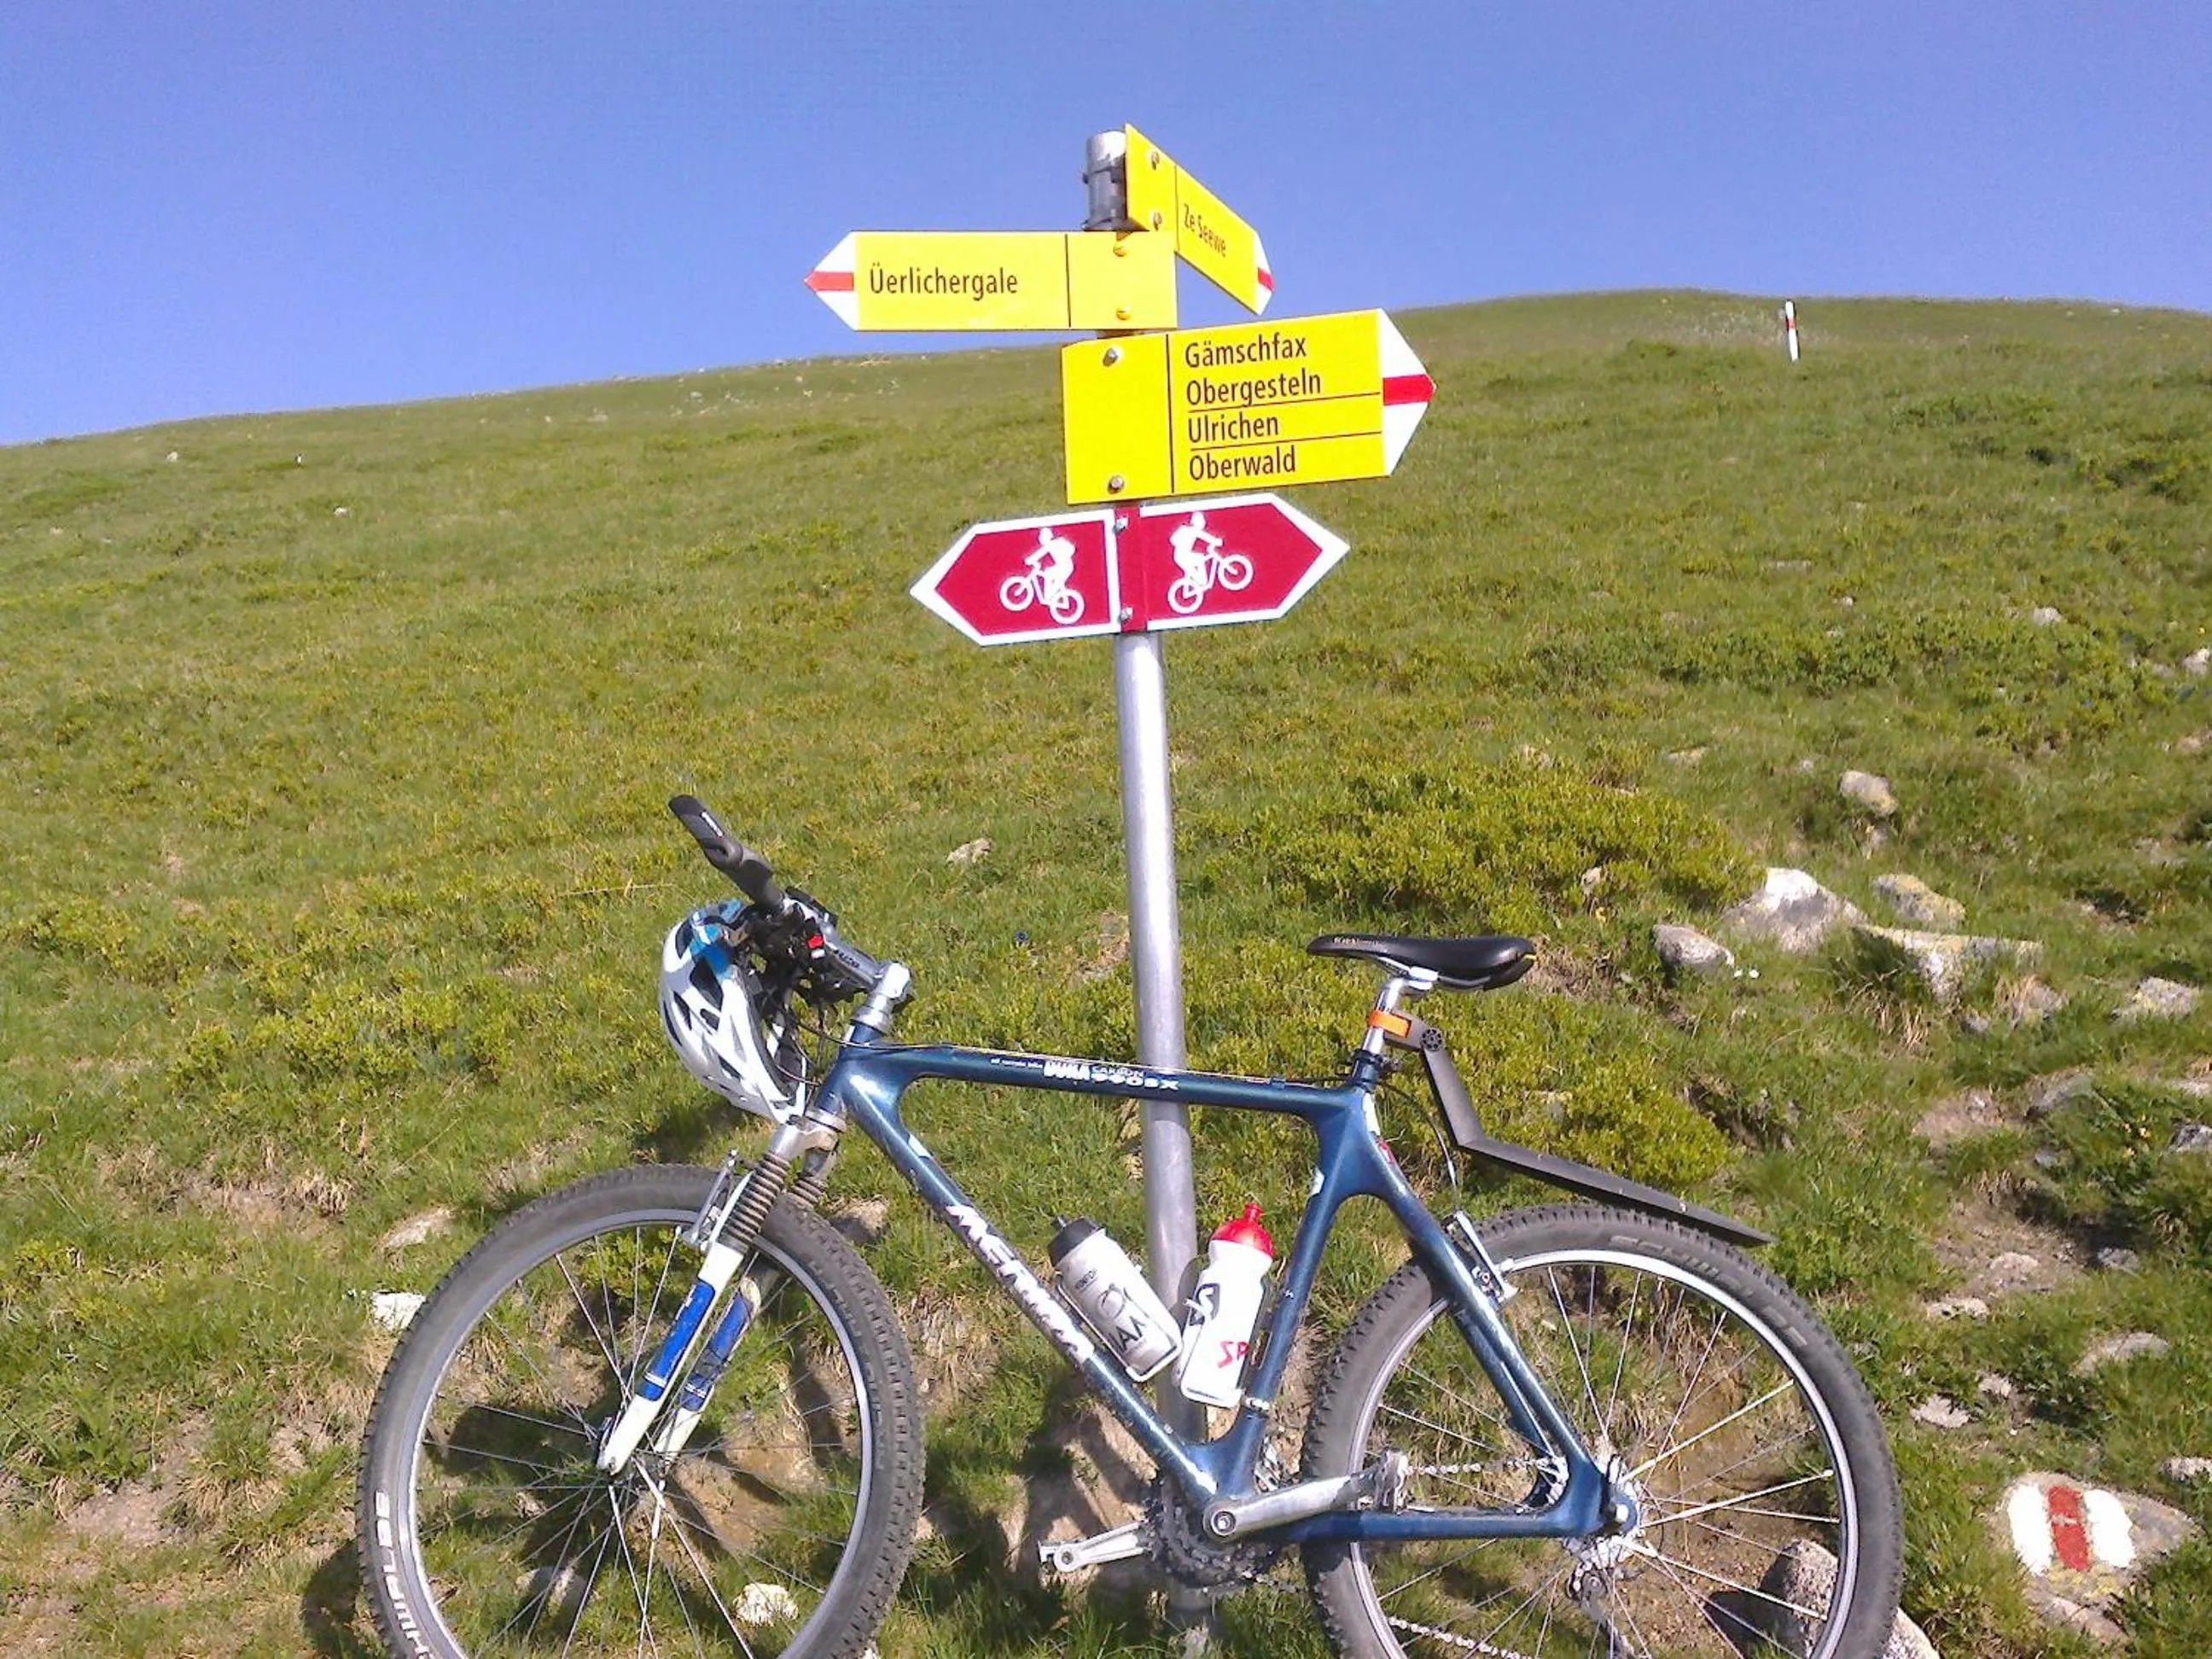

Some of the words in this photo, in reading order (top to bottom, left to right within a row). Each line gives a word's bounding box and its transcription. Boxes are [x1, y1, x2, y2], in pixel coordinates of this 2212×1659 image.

[1183, 203, 1196, 230] Ze
[1197, 213, 1227, 258] Seewe
[870, 263, 1018, 300] Üerlichergale
[1185, 332, 1307, 368] Gämschfax
[1186, 368, 1321, 406] Obergesteln
[1188, 411, 1278, 443] Ulrichen
[1189, 444, 1296, 480] Oberwald
[375, 1490, 437, 1659] HWALBE
